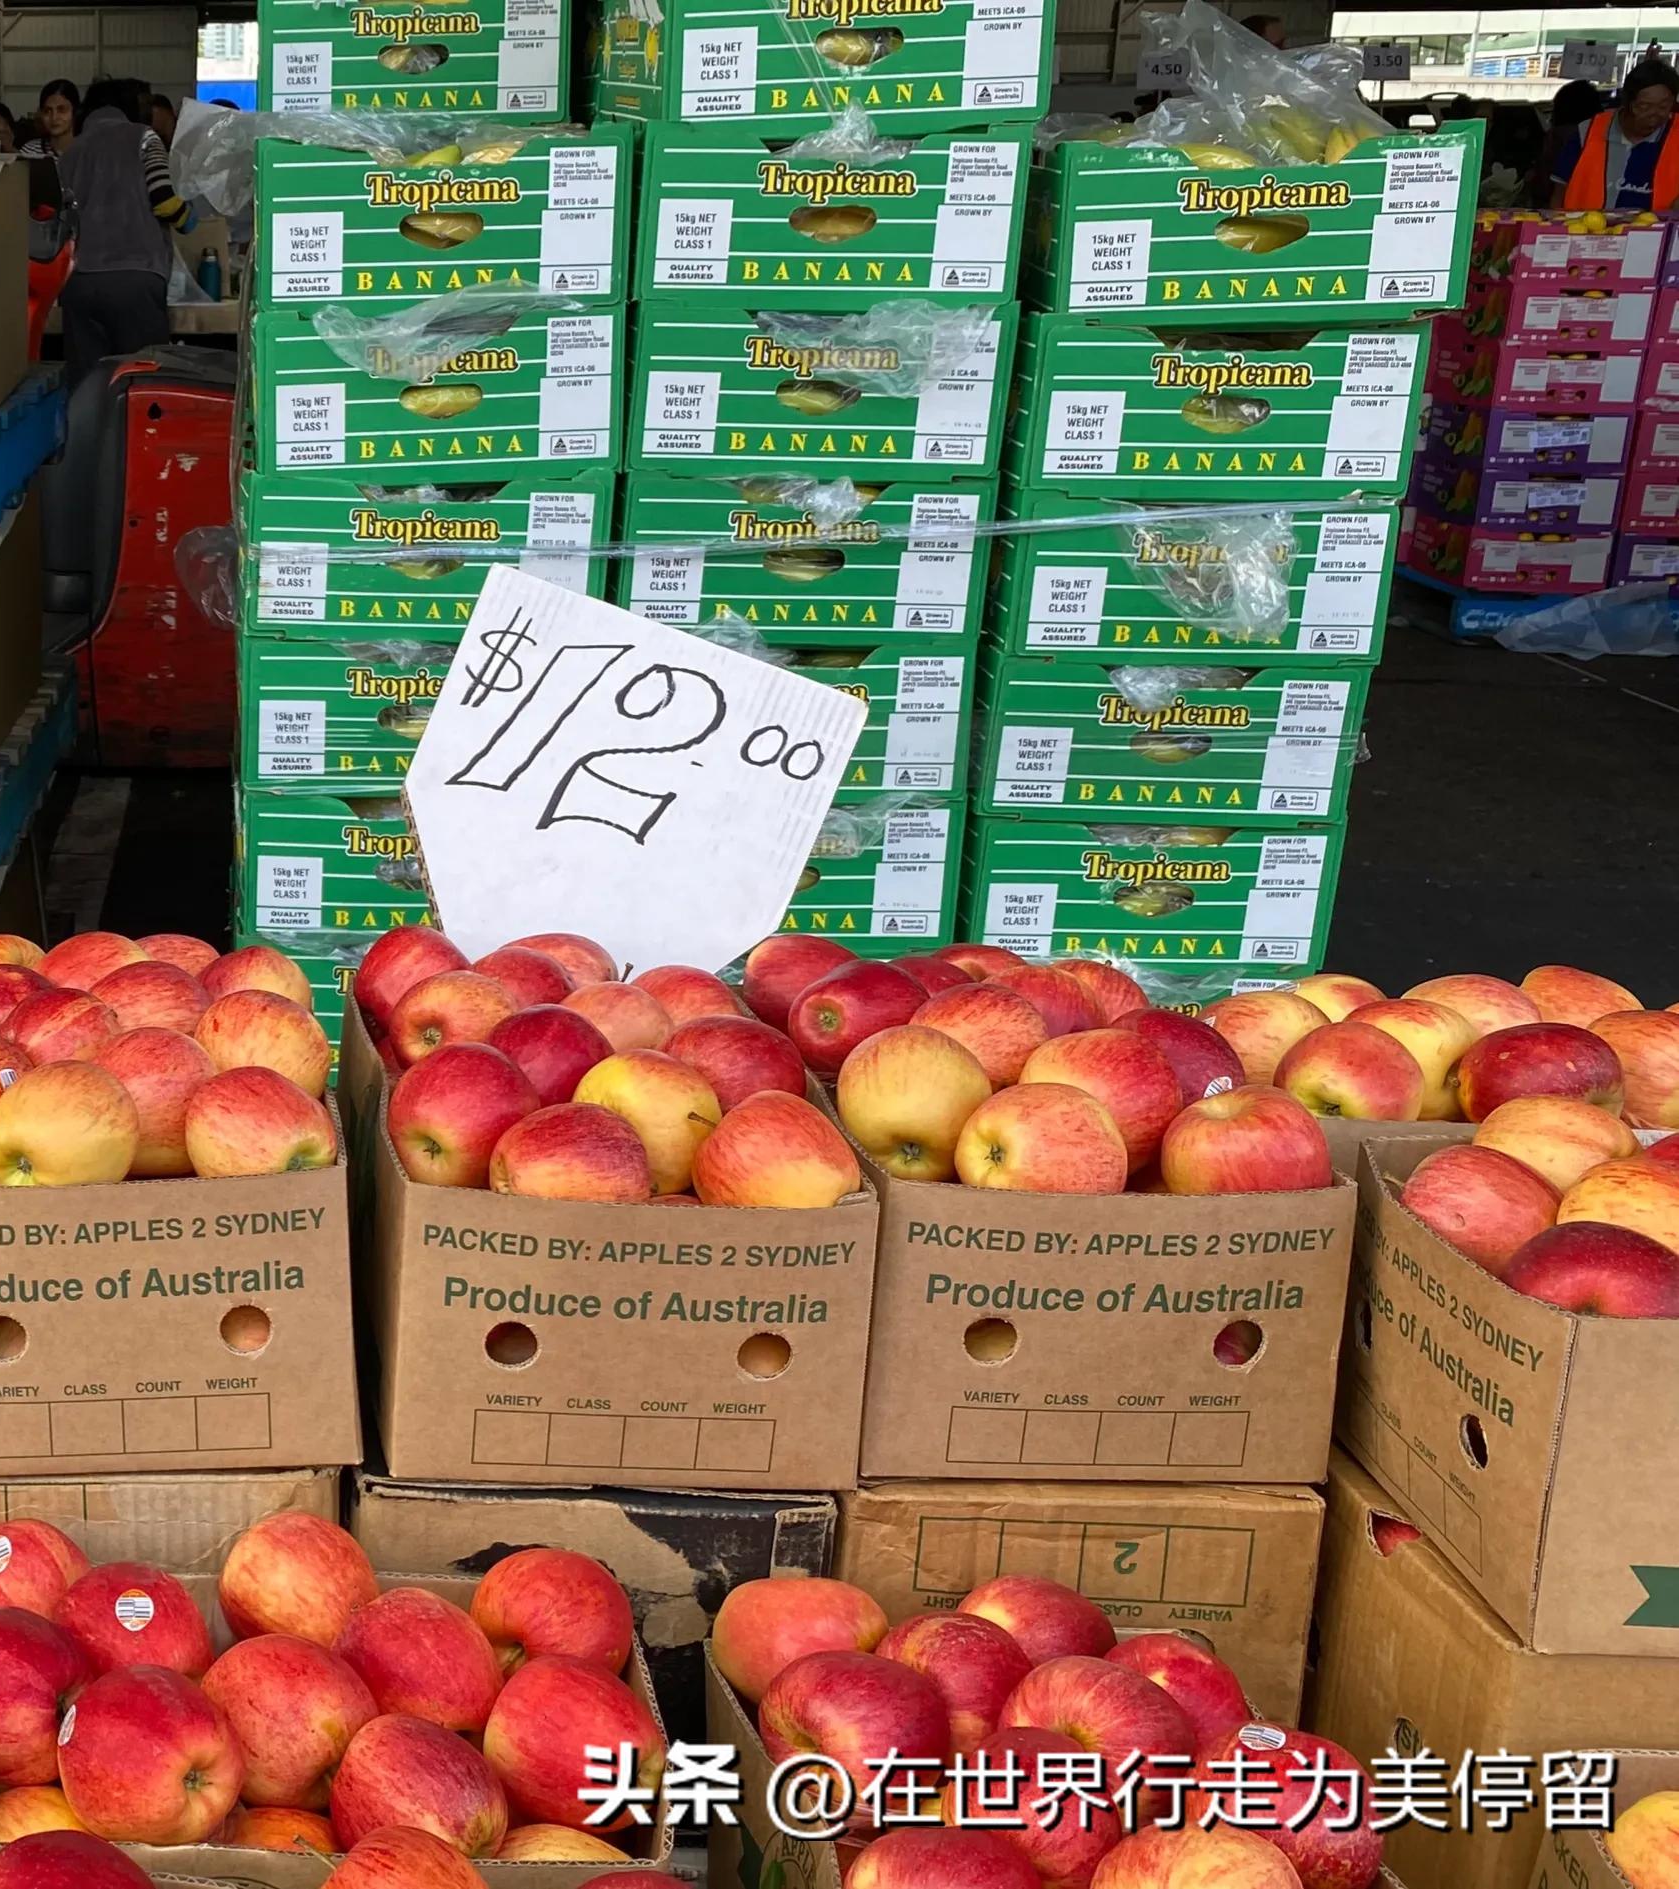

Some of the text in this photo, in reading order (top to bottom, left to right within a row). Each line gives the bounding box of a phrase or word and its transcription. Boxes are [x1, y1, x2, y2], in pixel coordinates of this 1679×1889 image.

[351, 9, 480, 42] Tropicana
[700, 42, 742, 56] 15kg NET
[702, 56, 739, 67] WEIGHT
[700, 70, 730, 81] CLASS
[345, 90, 483, 108] BANANA
[697, 95, 741, 103] QUALITY
[771, 81, 946, 109] BANANA
[695, 103, 742, 113] ASSURED
[365, 171, 520, 212] Tropicana
[758, 161, 916, 205] Tropicana
[1180, 175, 1352, 217] Tropicana
[289, 226, 329, 240] 15kg NET
[1091, 233, 1136, 248] 15kg NET
[291, 240, 326, 250] WEIGHT
[1093, 247, 1132, 258] WEIGHT
[290, 252, 319, 262] CLASS
[1091, 260, 1122, 271] CLASS
[287, 277, 329, 285] QUALITY
[356, 268, 522, 291] BANANA
[742, 262, 914, 282] BANANA
[286, 285, 330, 293] ASSURED
[1085, 294, 1134, 302] ASSURED
[1087, 285, 1133, 294] QUALITY
[1162, 275, 1348, 301] BANANA
[745, 335, 901, 380] Tropicana
[1152, 353, 1314, 394] Tropicana
[360, 434, 523, 459] BANANA
[729, 432, 897, 454] BANANA
[1132, 452, 1306, 472] BANANA
[351, 509, 501, 546] Tropicana
[338, 600, 471, 620] BANAN
[347, 668, 444, 704] Tropic
[1078, 783, 1243, 805] BANANA
[1082, 851, 1231, 888] Tropicana
[1065, 935, 1225, 956] BANANA
[74, 1217, 183, 1244] APPLES
[192, 1216, 207, 1239] 2
[214, 1207, 326, 1237] SYDNEY
[423, 1223, 538, 1256] PACKED
[598, 1241, 712, 1266] APPLES
[721, 1245, 736, 1267] 2
[745, 1241, 856, 1268] SYDNEY
[907, 1221, 1025, 1252] PACKED
[1084, 1233, 1198, 1257] APPLES
[1204, 1234, 1220, 1256] 2
[1228, 1227, 1336, 1256] SYDNEY
[95, 1269, 131, 1300] of
[143, 1260, 305, 1298] Australia
[443, 1275, 828, 1323] Produce of Australia
[926, 1273, 1304, 1313] Produce of Australia
[1391, 1246, 1446, 1310] APPLES
[1448, 1294, 1461, 1319] 2
[1462, 1303, 1545, 1373] SYDNEY
[1398, 1309, 1515, 1428] of Australia
[63, 1383, 107, 1396] CLASS
[135, 1380, 181, 1393] COUNT
[206, 1376, 258, 1391] WEIGHT
[486, 1393, 767, 1415] VARIETY CLASS COUNT WEIGHT
[963, 1390, 1242, 1407] VARIETY CLASS COUNT WEIGHT
[1413, 1434, 1439, 1466] COUNT
[1447, 1469, 1477, 1505] WEIGHT
[1113, 1541, 1140, 1575] 2
[922, 1594, 961, 1610] IGHT
[1168, 1606, 1234, 1622] VARIETY
